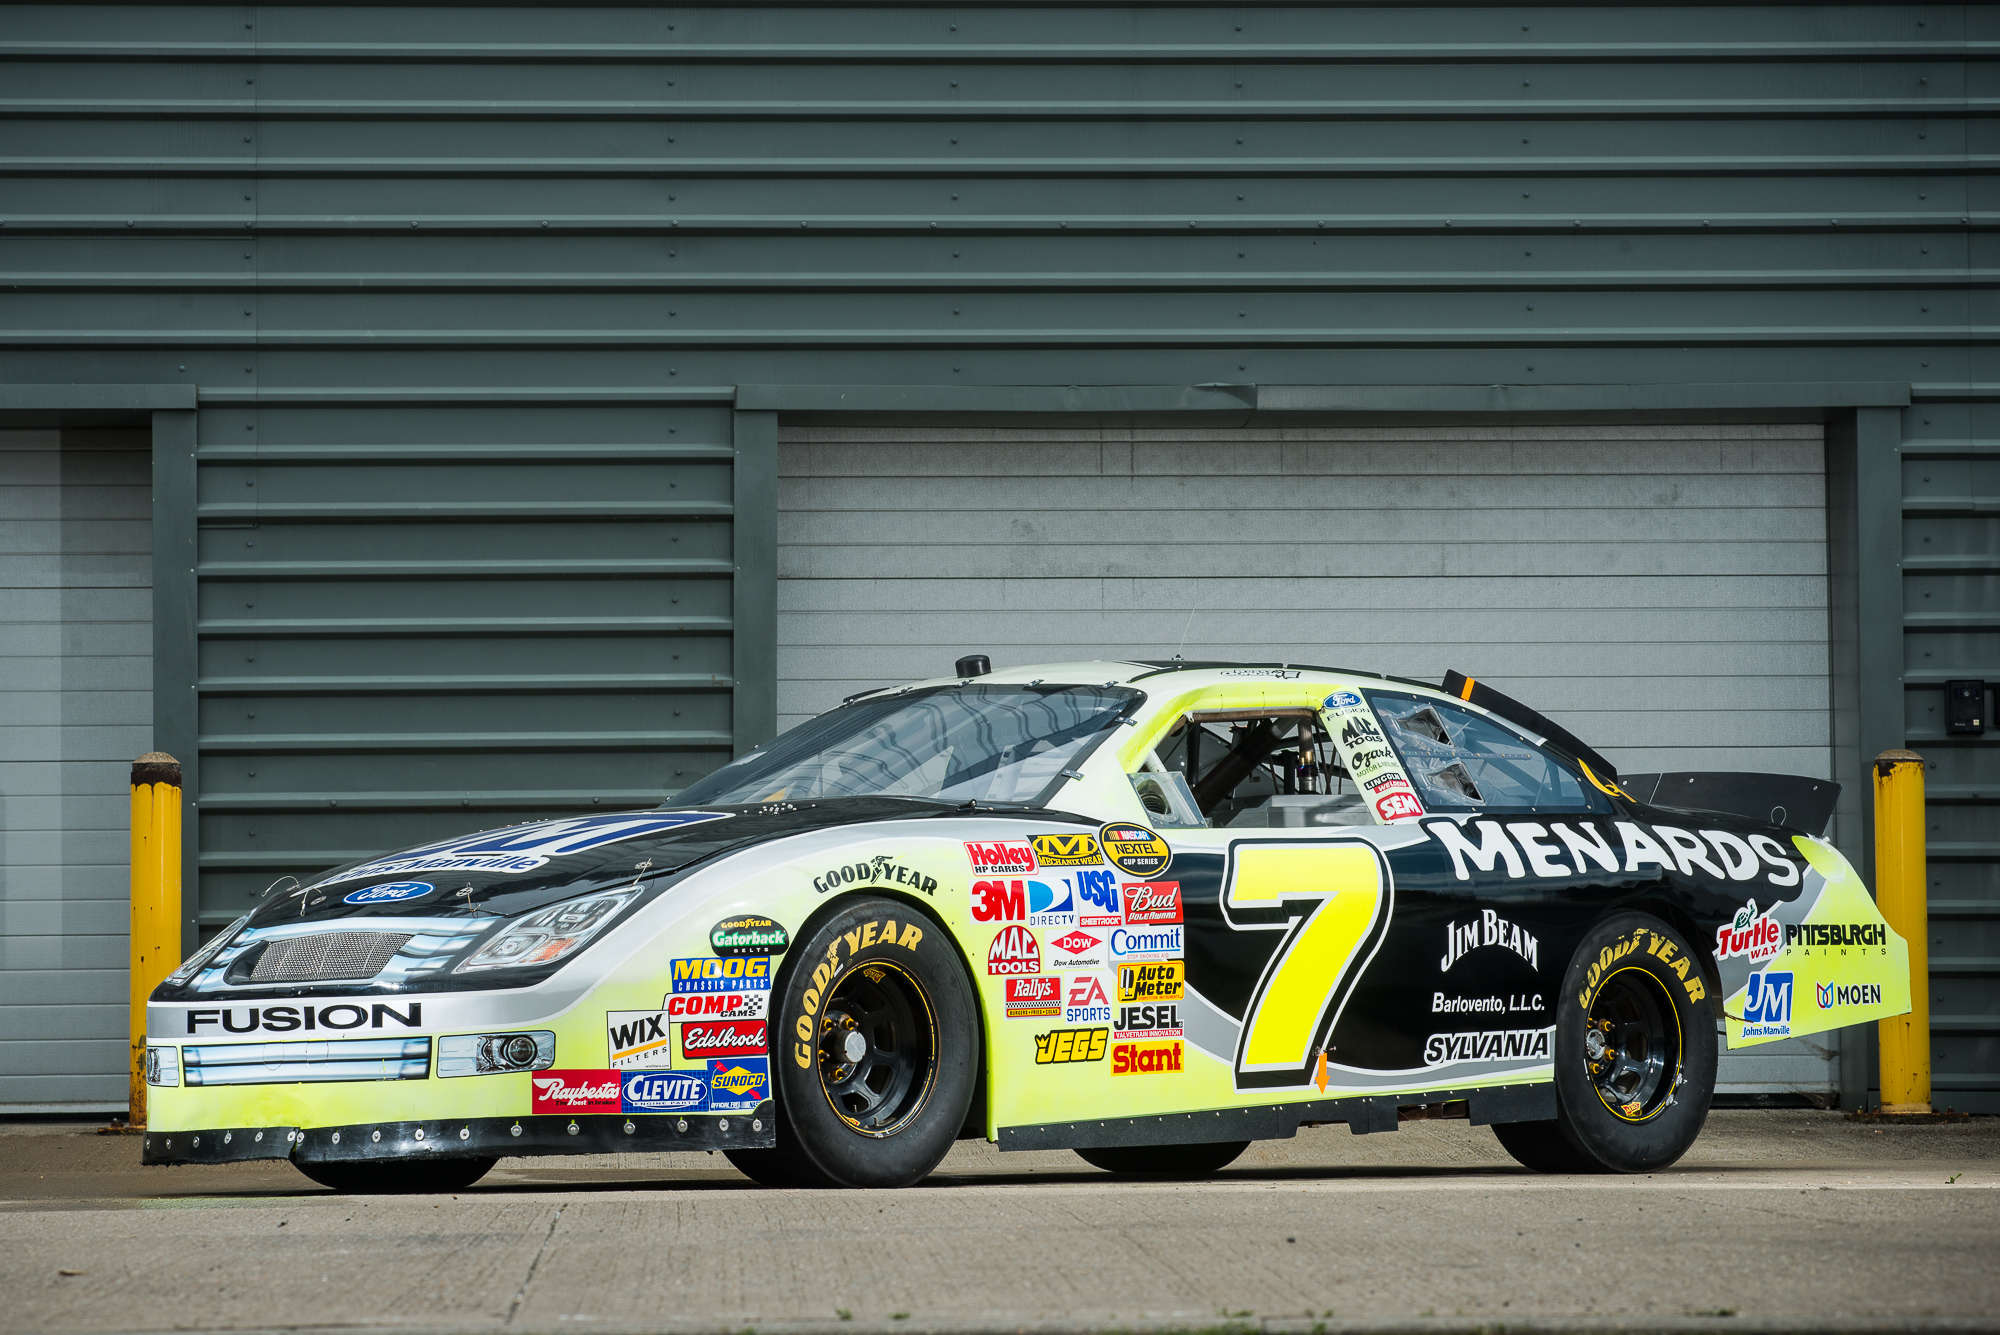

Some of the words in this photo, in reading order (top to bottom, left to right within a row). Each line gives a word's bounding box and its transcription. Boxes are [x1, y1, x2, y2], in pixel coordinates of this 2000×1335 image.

[1333, 694, 1356, 706] Ford
[1345, 736, 1383, 749] TOOLS
[1352, 747, 1393, 770] Ozark
[1357, 765, 1378, 777] MOTOR
[1365, 773, 1401, 790] LINCOLN
[1380, 795, 1421, 819] SEM
[967, 843, 1035, 871] Holley
[1038, 855, 1080, 866] MECHANIX
[1080, 854, 1104, 865] WEAR
[1114, 844, 1158, 854] NEXTEL
[1427, 820, 1800, 886] MENARDS
[991, 865, 1025, 873] CARBS
[356, 882, 421, 901] Ford
[972, 880, 1025, 921] 3M
[1077, 870, 1119, 913] USG
[1125, 886, 1178, 911] Bud
[721, 918, 771, 929] GOODYEAR
[1030, 915, 1074, 926] DIRECTV
[1081, 917, 1120, 925] SHEETROCK
[713, 931, 786, 947] Gatorback
[989, 927, 1039, 960] MAC
[1111, 928, 1181, 955] Commit
[1441, 920, 1479, 972] JIM
[1481, 909, 1539, 972] BEAM
[1719, 918, 1779, 956] Turtle
[1786, 924, 1886, 946] PITTSBURGH
[1228, 844, 1383, 1073] 7
[1751, 944, 1777, 959] WAX
[673, 958, 768, 980] MOOG
[989, 961, 1039, 974] TOOLS
[1137, 965, 1175, 981] Auto
[678, 980, 724, 992] CHASSIS
[732, 979, 764, 989] PARTS
[1068, 977, 1109, 1006] EA
[1135, 981, 1182, 998] Meter
[1838, 984, 1881, 1005] MOEN
[669, 995, 743, 1016] COMP
[1432, 992, 1506, 1014] Barlovento,
[1510, 994, 1545, 1011] L.L.C.
[187, 1002, 422, 1034] FUSION
[1067, 1007, 1110, 1022] SPORTS
[1114, 1005, 1180, 1030] JESEL
[610, 1014, 666, 1050] WIX
[685, 1027, 765, 1050] Edelbrock
[1116, 1031, 1148, 1039] VALVETRAIN
[1742, 1026, 1763, 1037] Johns
[1764, 1025, 1790, 1035] Manville
[1035, 1027, 1109, 1064] JEGS
[1426, 1032, 1549, 1062] SYLVANIA
[612, 1048, 667, 1068] FILTERS
[1113, 1043, 1181, 1073] Stant
[533, 1078, 620, 1106] Raybestos
[628, 1075, 702, 1101] CLEVITE
[713, 1074, 765, 1088] SUNOCO
